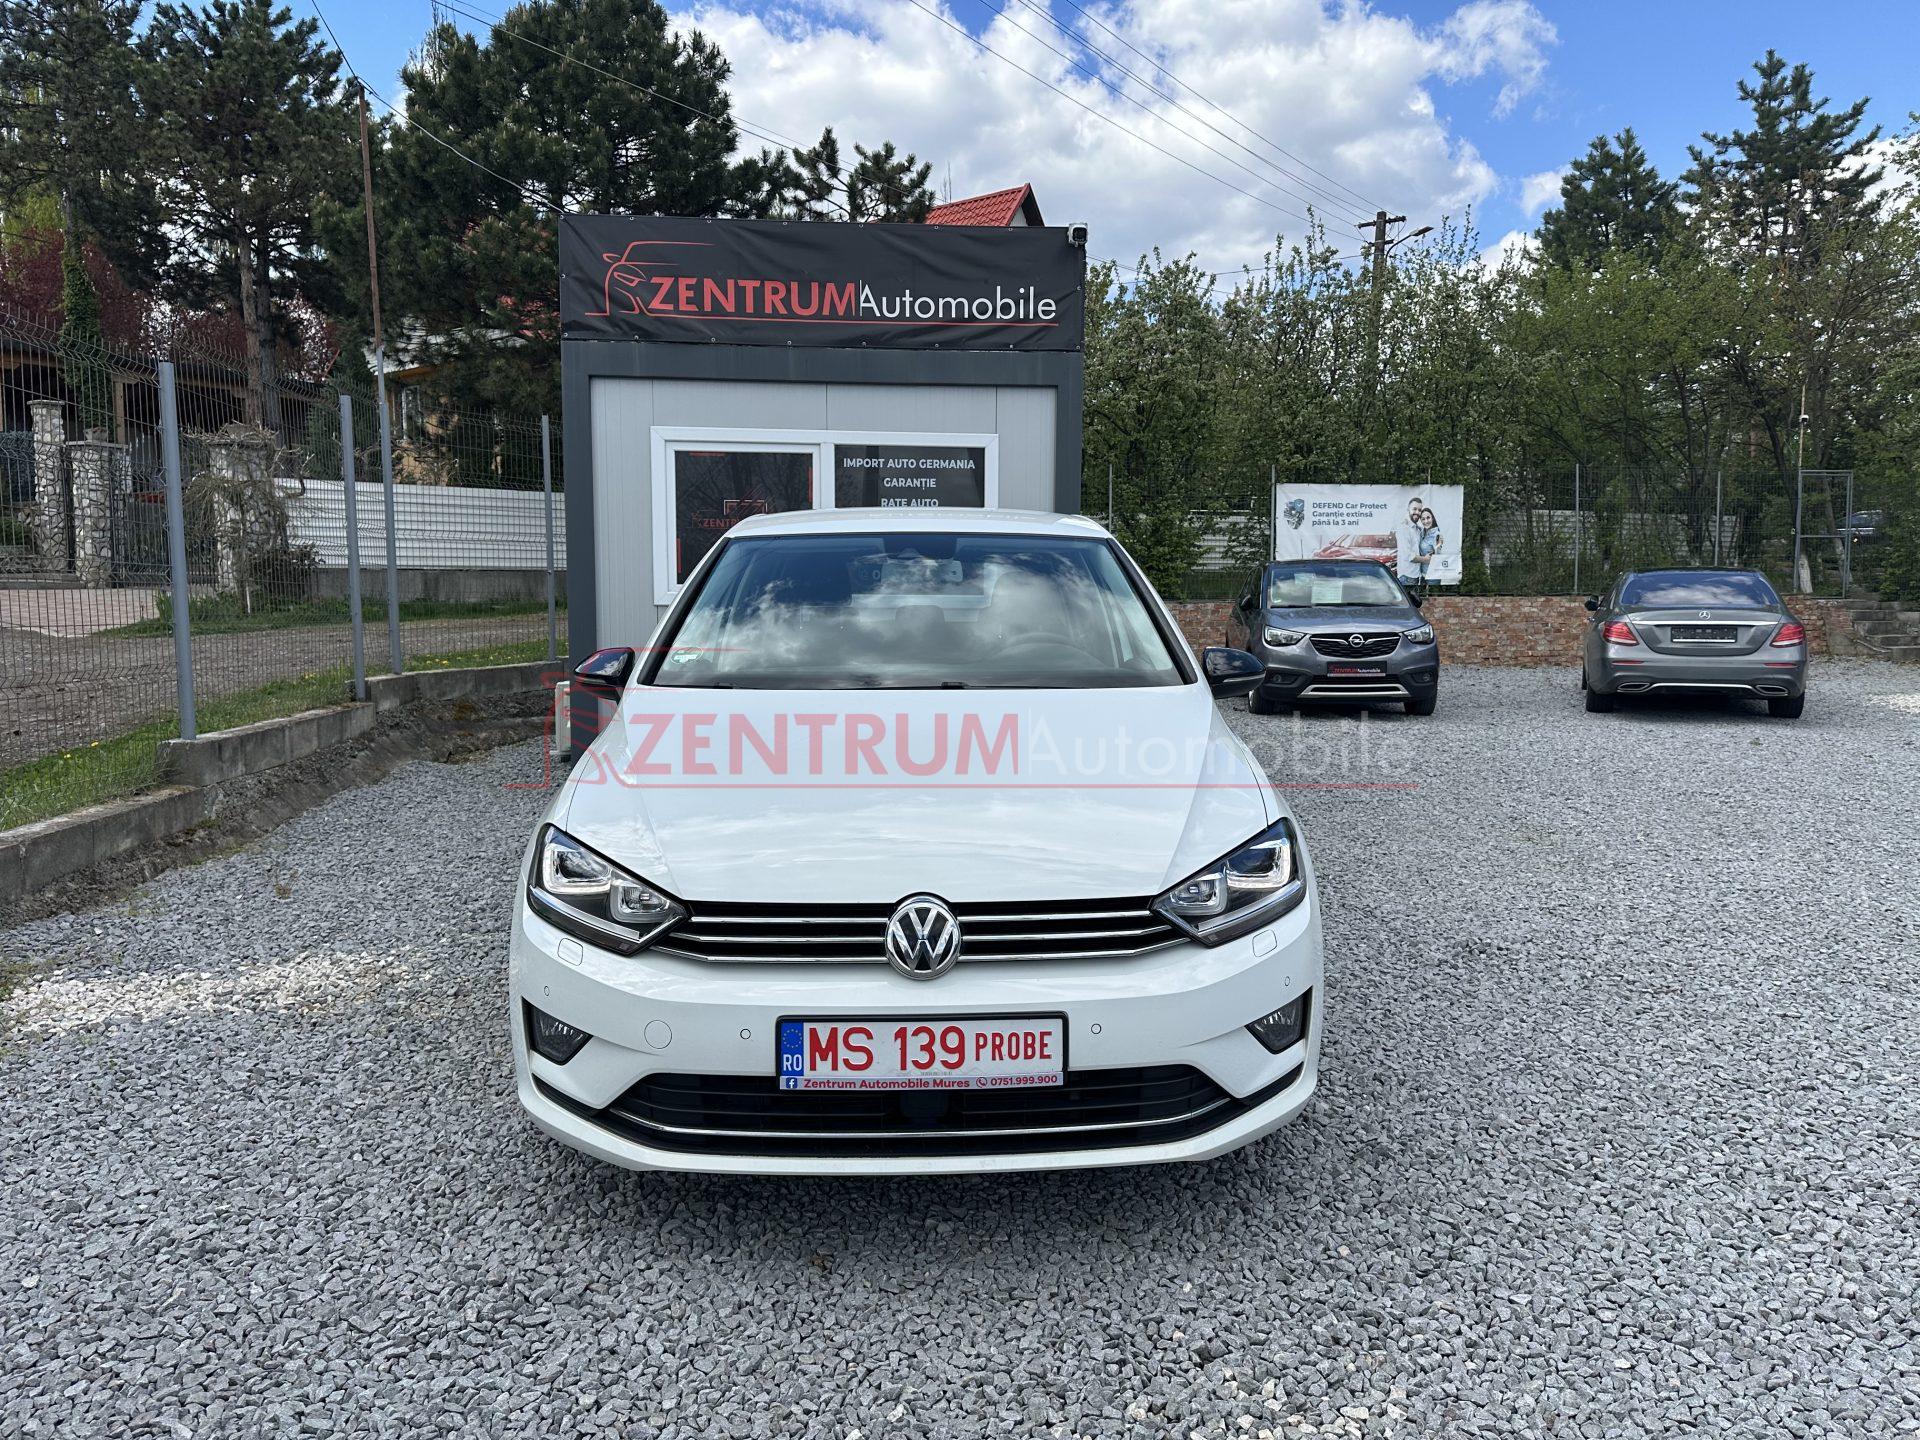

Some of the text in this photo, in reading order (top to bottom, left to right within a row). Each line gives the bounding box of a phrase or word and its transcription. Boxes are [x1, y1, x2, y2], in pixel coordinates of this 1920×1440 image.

[648, 276, 1057, 320] ZENTRUM Automobile
[843, 457, 976, 469] IMPORT AUTO GERMANIA
[881, 498, 939, 507] RATE AUTO
[783, 1025, 1053, 1072] RO MS 139 PROBE
[804, 1075, 1058, 1089] Zentrum Automobile Mures 0751.999.900
